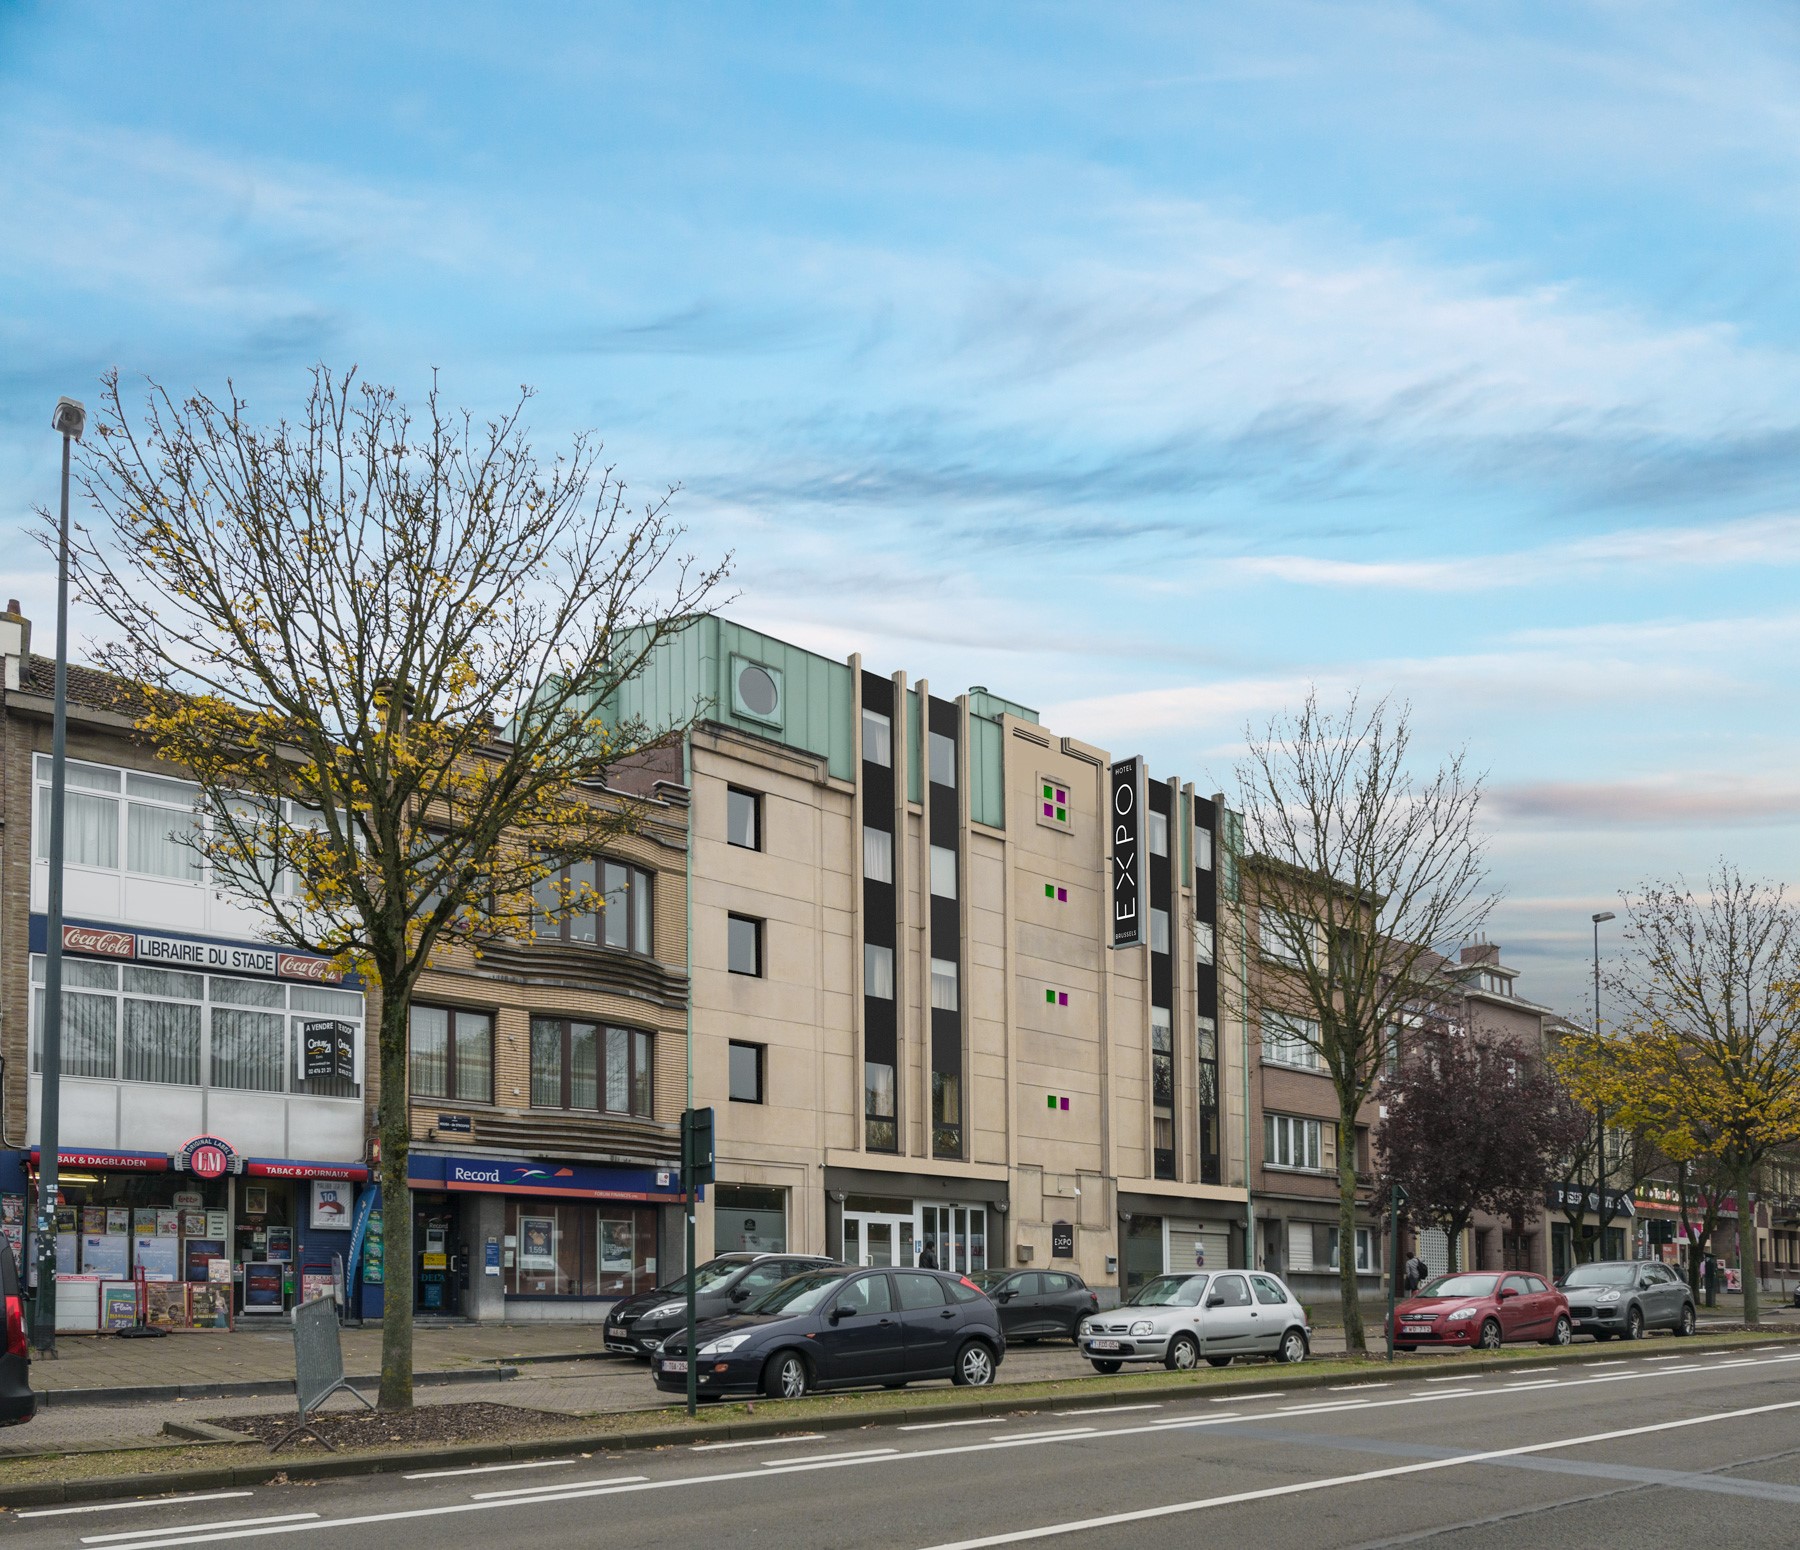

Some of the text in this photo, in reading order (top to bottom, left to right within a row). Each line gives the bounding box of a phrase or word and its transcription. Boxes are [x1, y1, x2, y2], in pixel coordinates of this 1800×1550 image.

[1115, 764, 1133, 775] HOTEL
[1115, 783, 1136, 921] EXPO
[64, 928, 132, 955] Coca-Cola
[1115, 929, 1137, 940] BRUSSELS
[140, 939, 274, 971] LIBRAIRIE DU STADE
[305, 1022, 334, 1032] A VENDRE
[186, 1139, 232, 1155] ORIGINAL LABEL
[78, 1156, 86, 1165] &
[87, 1157, 147, 1168] DAGBLADEN
[197, 1151, 222, 1173] L&M
[265, 1166, 293, 1176] TABAC
[303, 1169, 349, 1179] JOURNAUX
[455, 1167, 500, 1183] Record
[1054, 1238, 1072, 1246] EXPO
